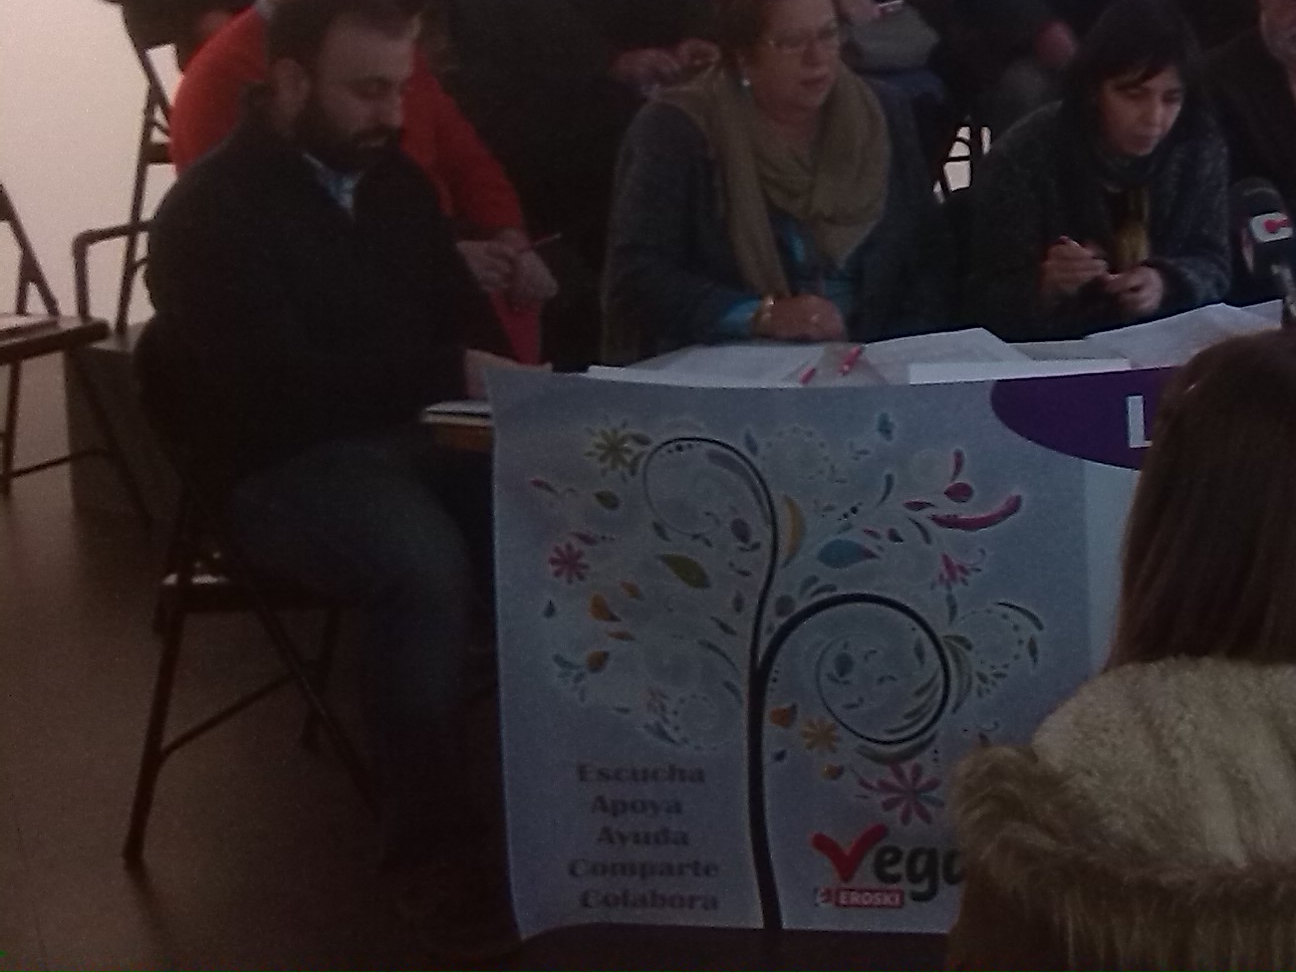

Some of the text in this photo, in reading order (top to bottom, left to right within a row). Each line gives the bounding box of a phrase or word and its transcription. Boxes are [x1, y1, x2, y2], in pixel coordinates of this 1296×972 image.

[576, 764, 706, 785] Escucha
[590, 794, 684, 818] Apoya
[597, 825, 690, 849] Ayuda
[568, 857, 719, 881] Comparte
[579, 888, 721, 912] Colabora
[837, 891, 903, 906] EROSKI
